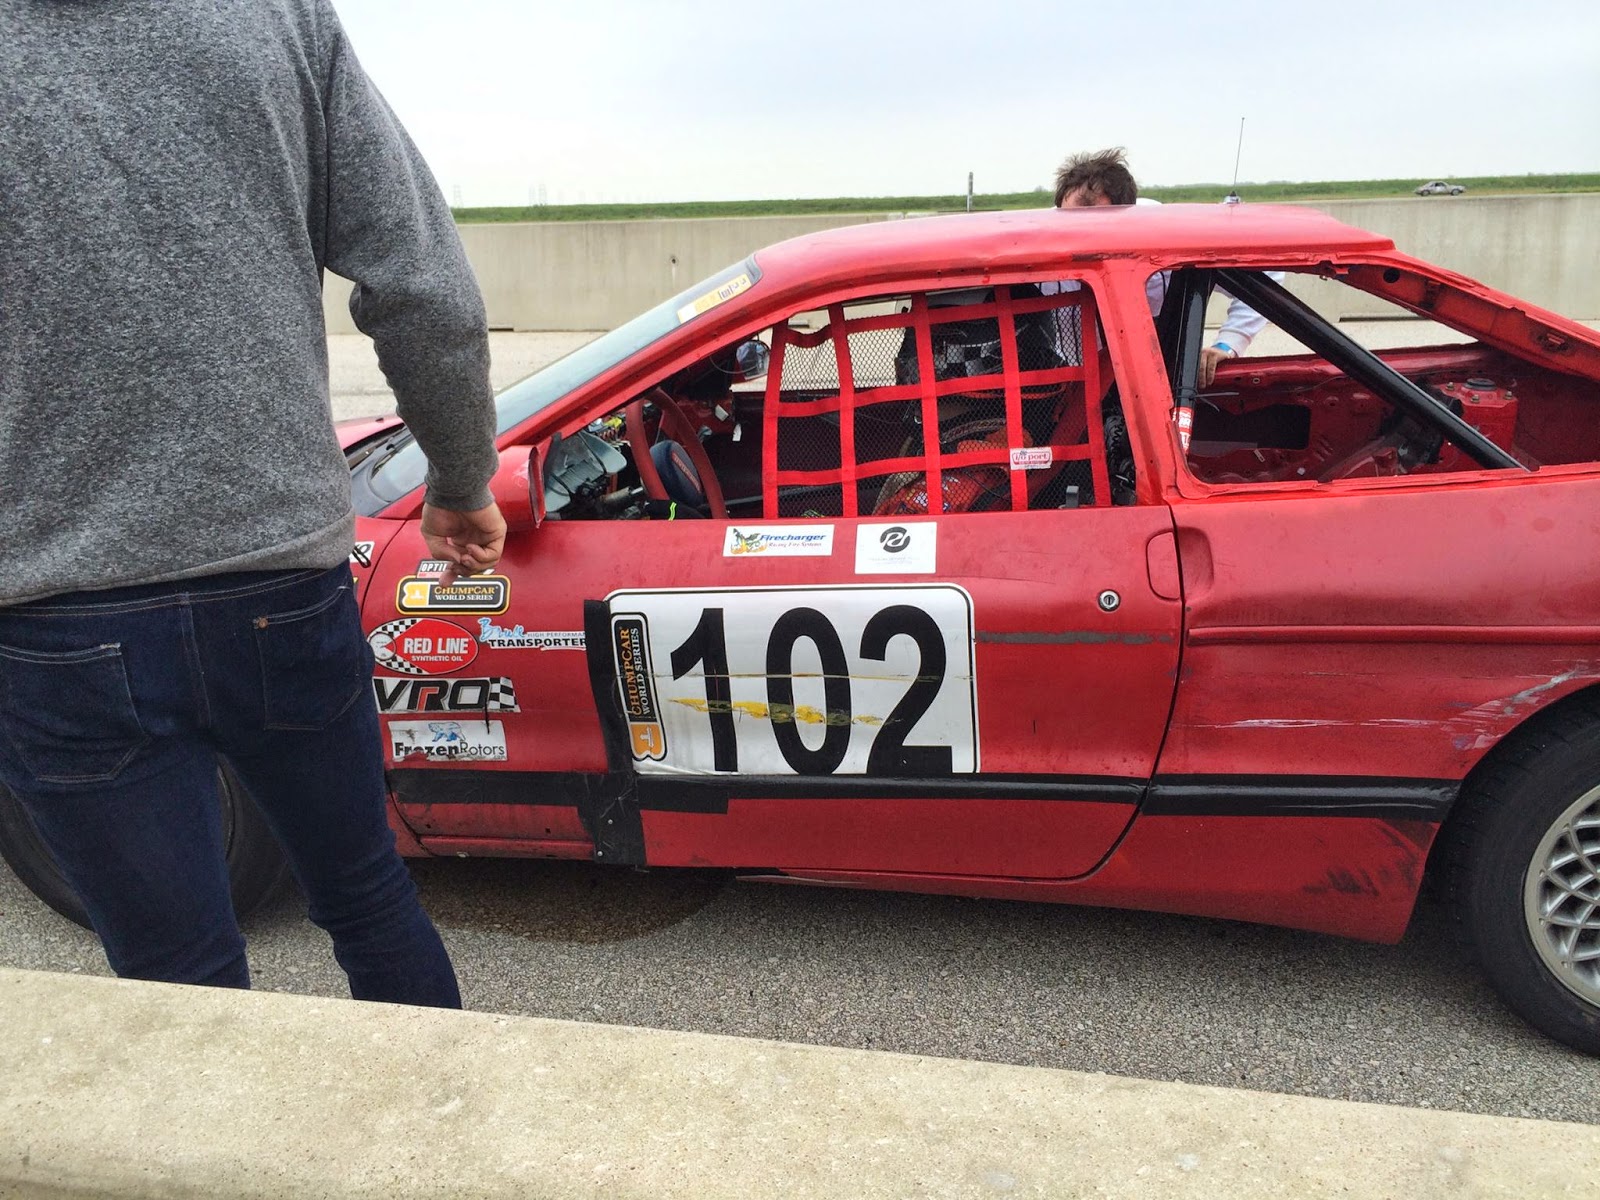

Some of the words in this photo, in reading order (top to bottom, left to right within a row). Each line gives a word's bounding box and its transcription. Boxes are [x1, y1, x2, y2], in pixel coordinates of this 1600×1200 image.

[1028, 453, 1048, 461] port
[760, 534, 827, 542] Firecharger
[434, 586, 495, 594] CHUMPCAR
[403, 638, 432, 654] RED
[437, 638, 468, 654] LINE
[630, 627, 644, 672] SERIES
[620, 628, 642, 716] CHUMPCAR
[373, 678, 490, 711] VRO
[637, 674, 650, 715] WORLD
[670, 604, 953, 774] 102
